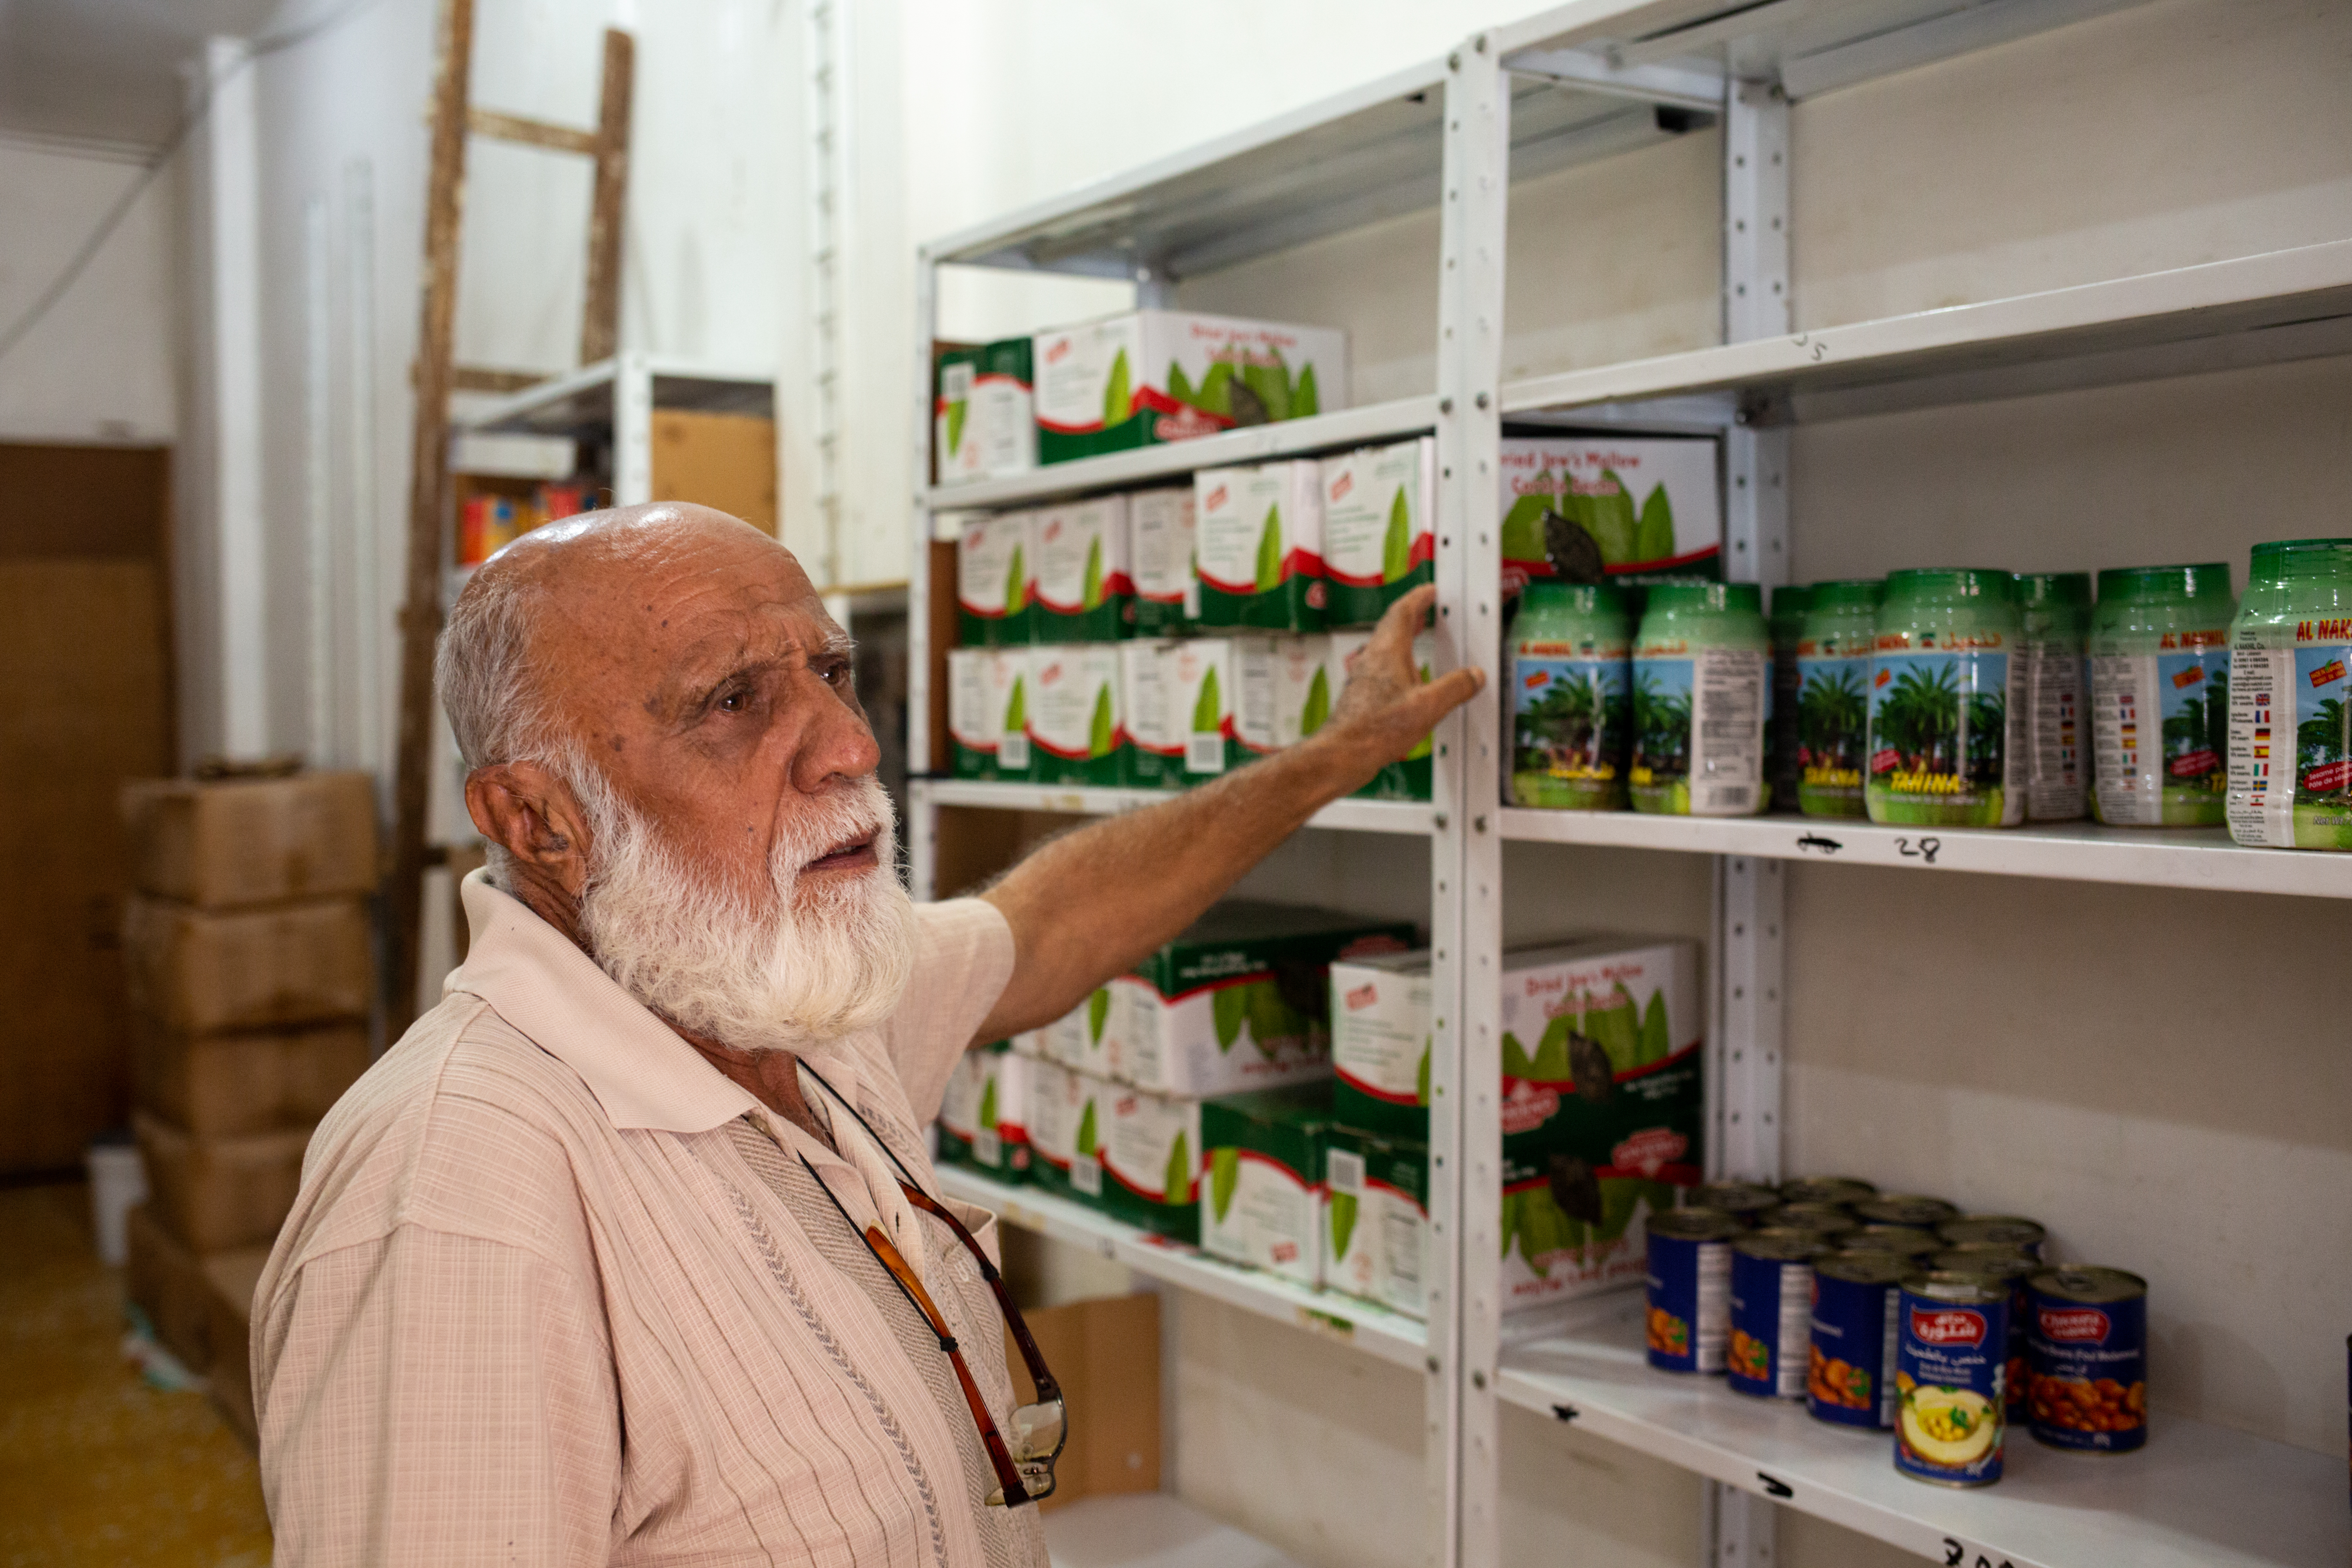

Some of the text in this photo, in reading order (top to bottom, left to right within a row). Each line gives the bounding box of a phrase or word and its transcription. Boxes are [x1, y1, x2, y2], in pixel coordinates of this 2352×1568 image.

[1499, 452, 1536, 469] ried
[2296, 618, 2352, 641] AL NAK
[2308, 768, 2334, 781] Sesame
[2314, 816, 2329, 825] Net
[1894, 837, 1940, 864] 28
